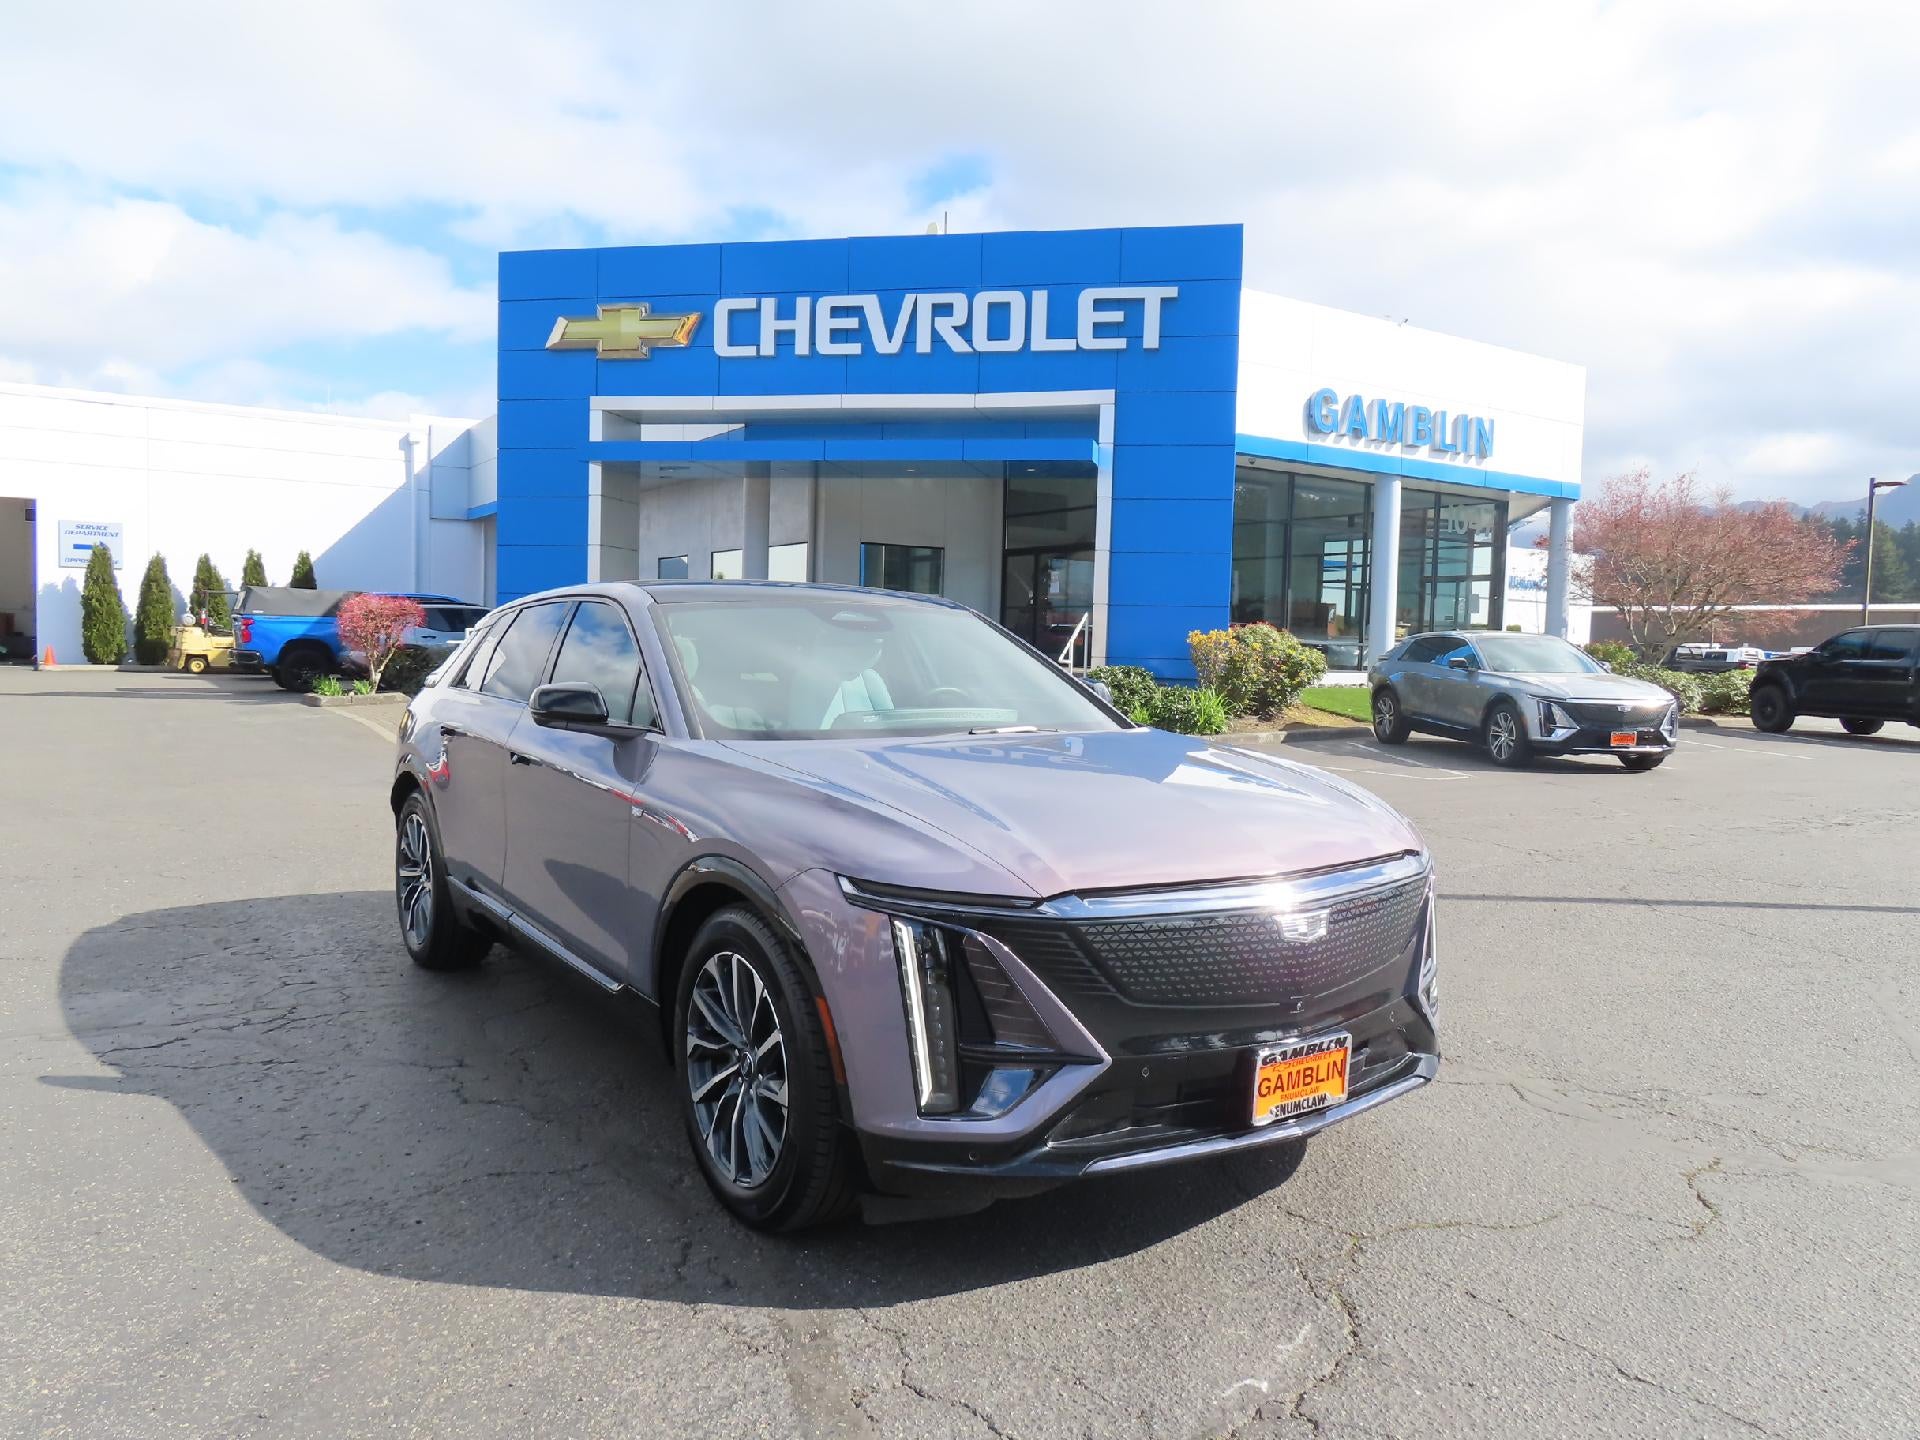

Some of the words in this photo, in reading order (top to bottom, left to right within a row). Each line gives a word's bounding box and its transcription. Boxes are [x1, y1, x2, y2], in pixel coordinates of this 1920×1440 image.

[714, 286, 1179, 357] CHEVROLET
[1305, 388, 1494, 459] GAMBLIN
[64, 529, 119, 537] DEPARTMENT
[75, 523, 108, 531] SERVICE
[1262, 1037, 1348, 1066] GAMBLIN
[1257, 1058, 1343, 1098] GAMBLIN
[1274, 1093, 1327, 1116] ENUMCLAW
